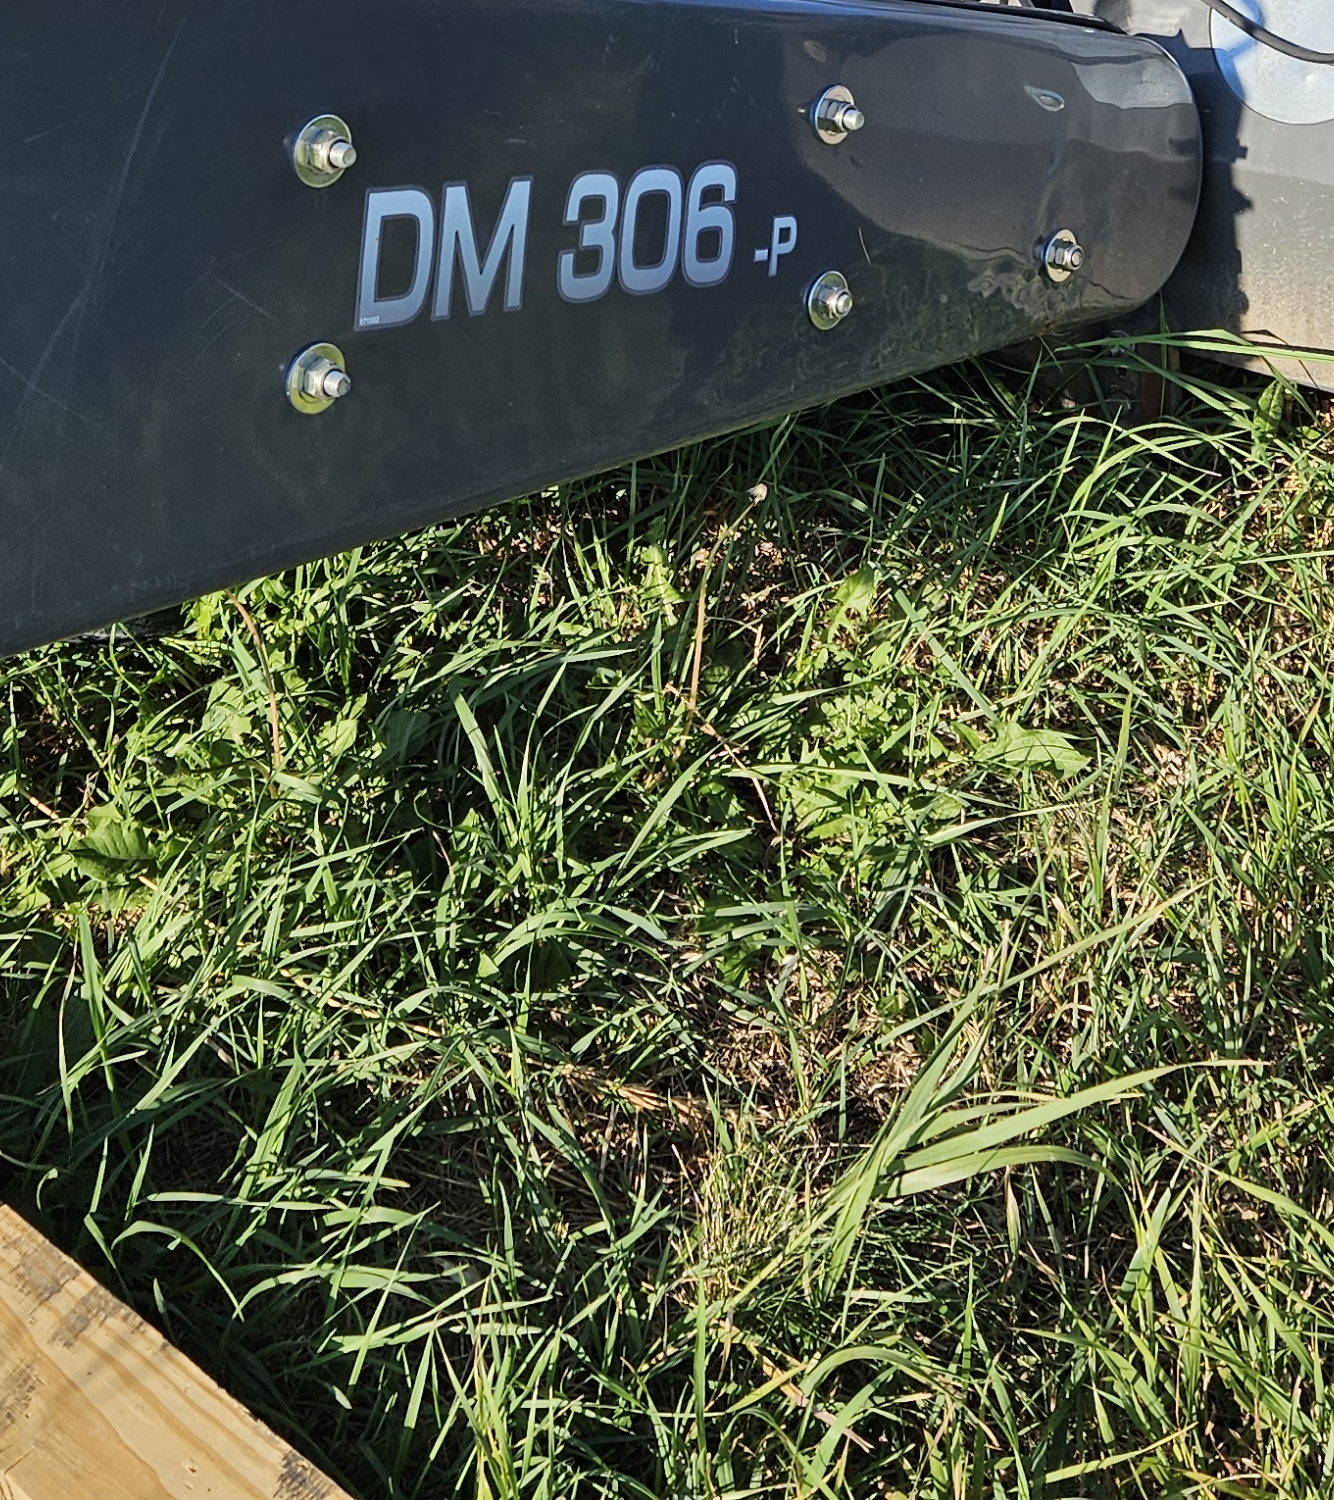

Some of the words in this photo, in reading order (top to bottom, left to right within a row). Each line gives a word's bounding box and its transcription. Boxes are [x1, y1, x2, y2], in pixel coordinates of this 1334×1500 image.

[355, 175, 534, 332] DM
[557, 159, 738, 303] 306
[753, 215, 798, 277] -P
